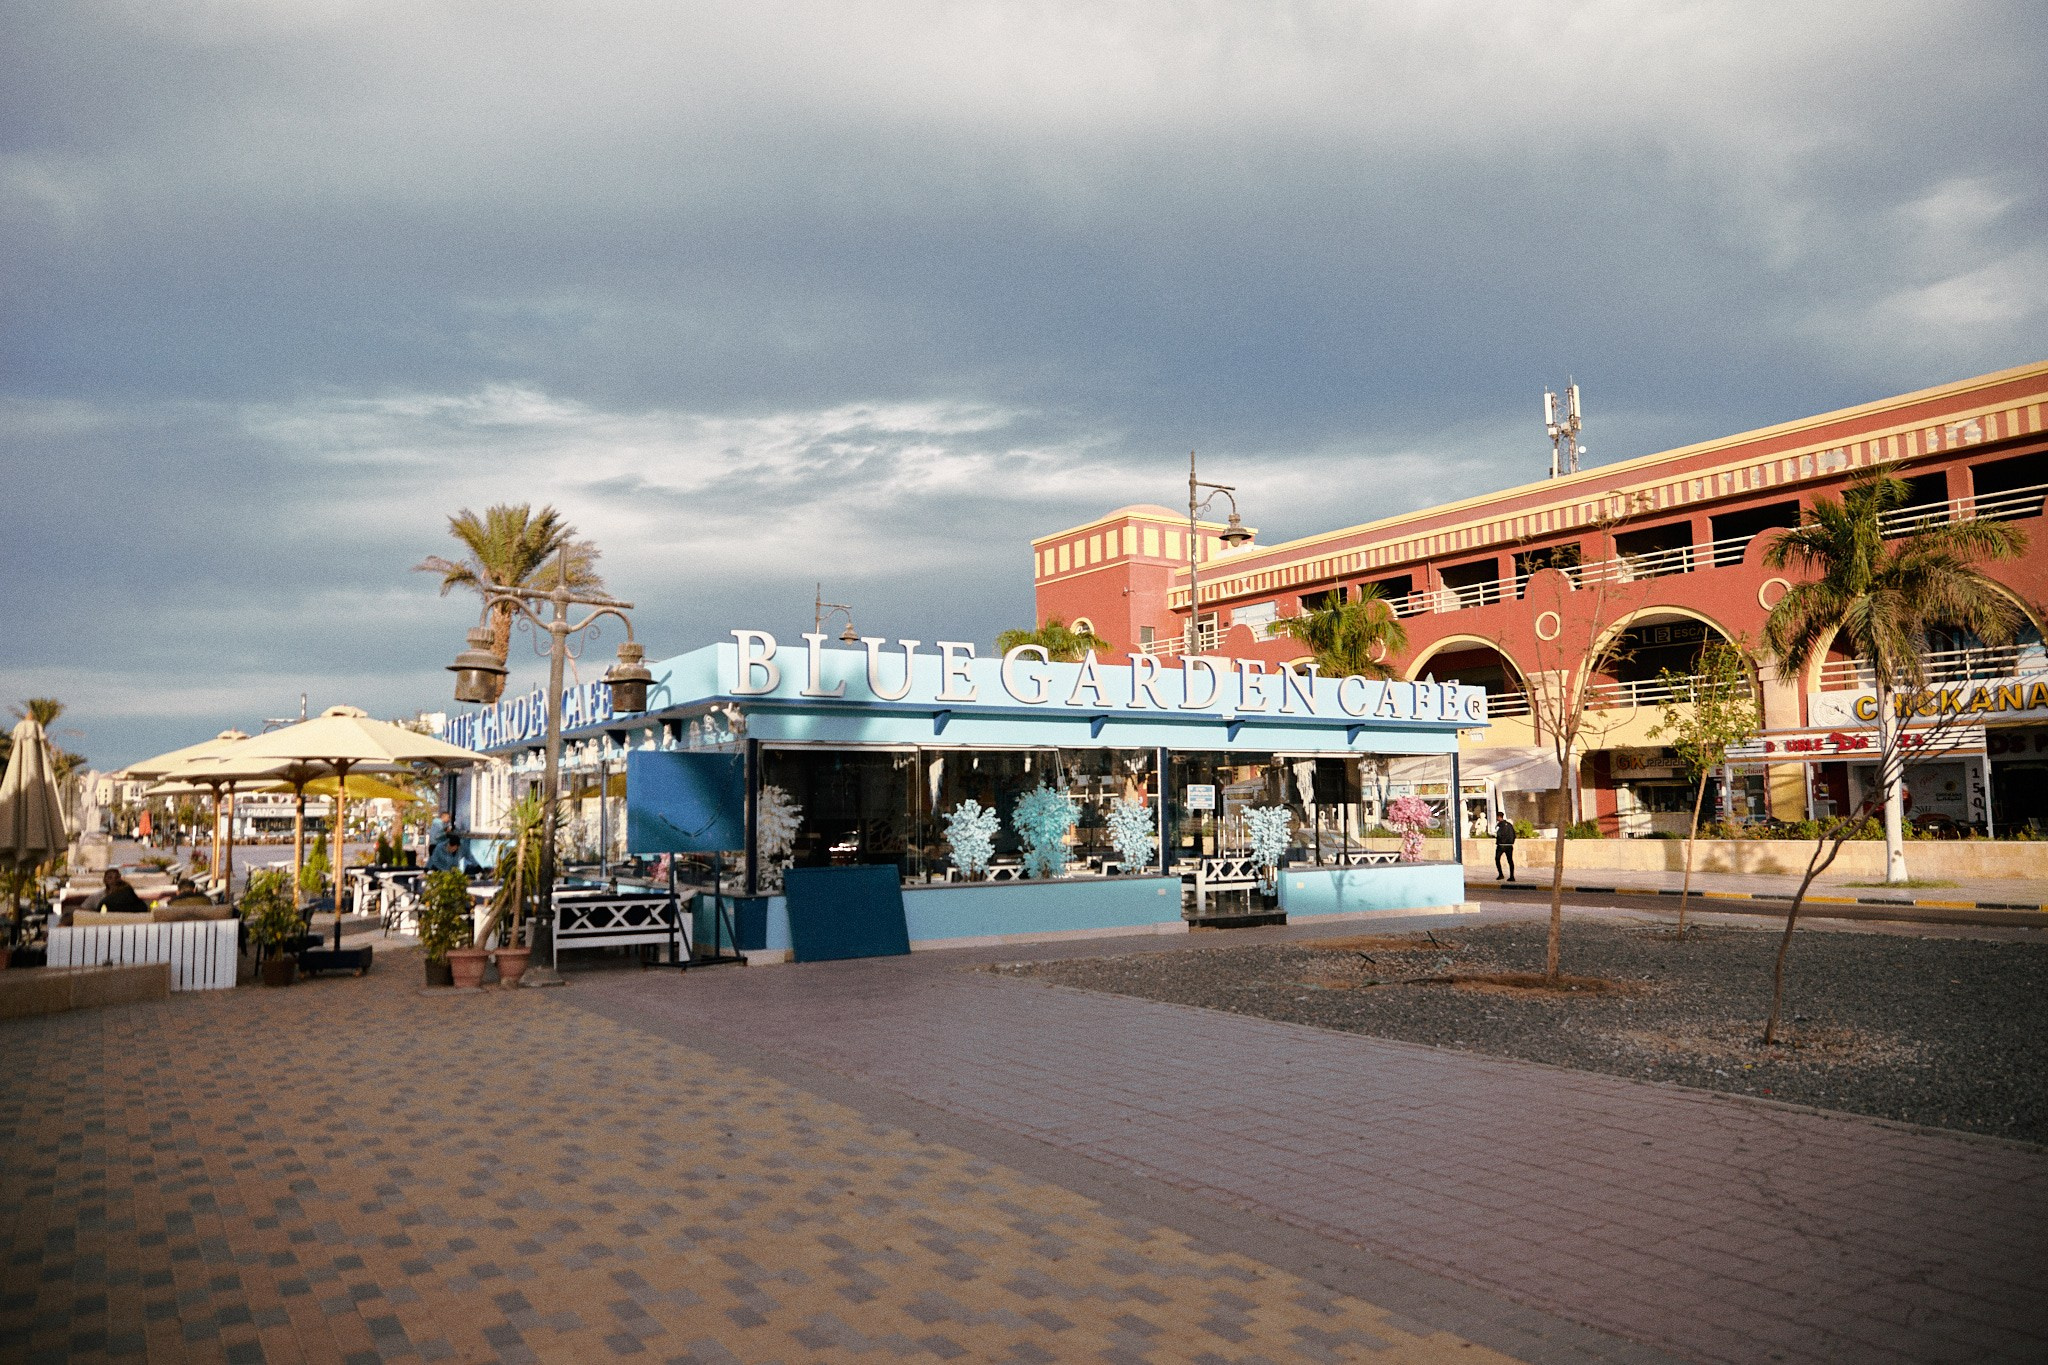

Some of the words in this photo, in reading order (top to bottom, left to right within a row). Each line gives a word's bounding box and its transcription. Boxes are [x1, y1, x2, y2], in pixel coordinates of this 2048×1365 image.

[729, 630, 978, 702] BLUE
[1000, 643, 1321, 715] GARDEN
[480, 688, 550, 749] GARDEN
[1616, 754, 1646, 770] GK
[247, 808, 277, 816] PIANO
